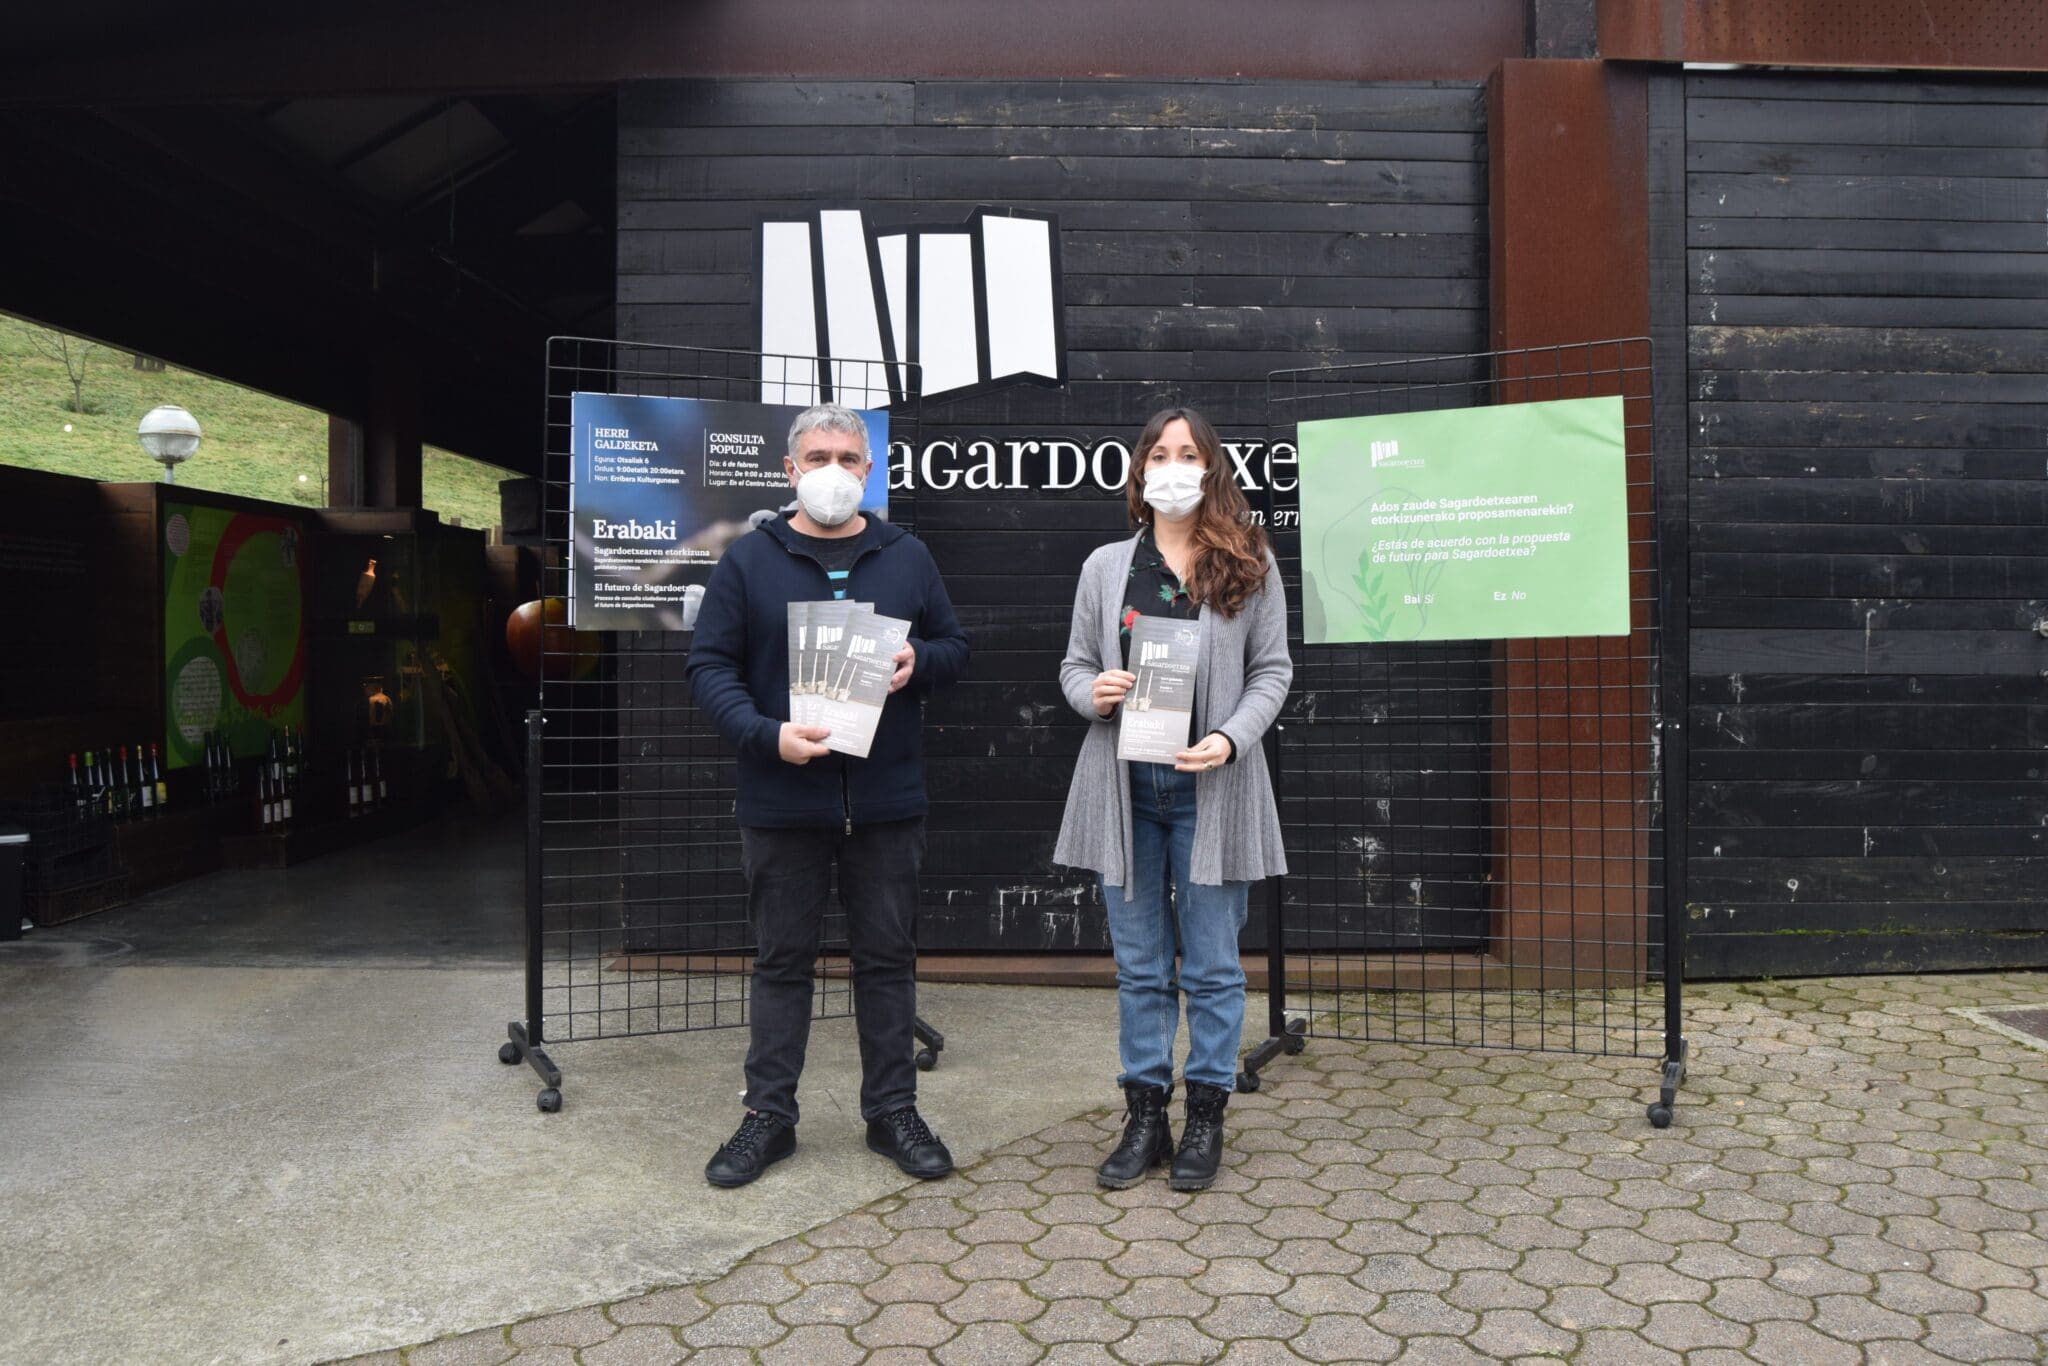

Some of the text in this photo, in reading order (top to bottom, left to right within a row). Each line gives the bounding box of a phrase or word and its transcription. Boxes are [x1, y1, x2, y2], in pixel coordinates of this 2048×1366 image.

[595, 428, 630, 439] HERRI
[709, 433, 766, 445] CONSULTA
[594, 440, 659, 452] GALDEKETA
[709, 444, 759, 456] POPULAR
[594, 455, 617, 464] Eguna:
[644, 457, 650, 465] 6
[722, 460, 728, 468] 6
[728, 460, 736, 468] de
[737, 460, 759, 469] febrero
[594, 465, 615, 473] Ordua:
[709, 469, 734, 478] Horario:
[734, 470, 743, 478] De
[744, 470, 758, 478] 9:00
[764, 471, 781, 479] 20:00
[709, 479, 729, 487] Lugar:
[766, 480, 789, 488] Cultural
[1371, 494, 1538, 513] Ados zaude Sagardoetxearen
[1371, 503, 1574, 525] etorkizunerako proposamenarekin?
[593, 518, 677, 540] Erabaki
[1372, 531, 1571, 553] ¿Estás de acuerdo con la propuesta
[594, 546, 711, 558] Sagardoetxearen etorkizuna
[1372, 545, 1537, 563] de futuro para Sagardoetxea?
[594, 582, 603, 591] El
[604, 582, 631, 592] futuro
[632, 583, 643, 592] de
[1493, 591, 1508, 601] Ez
[1511, 590, 1527, 601] No
